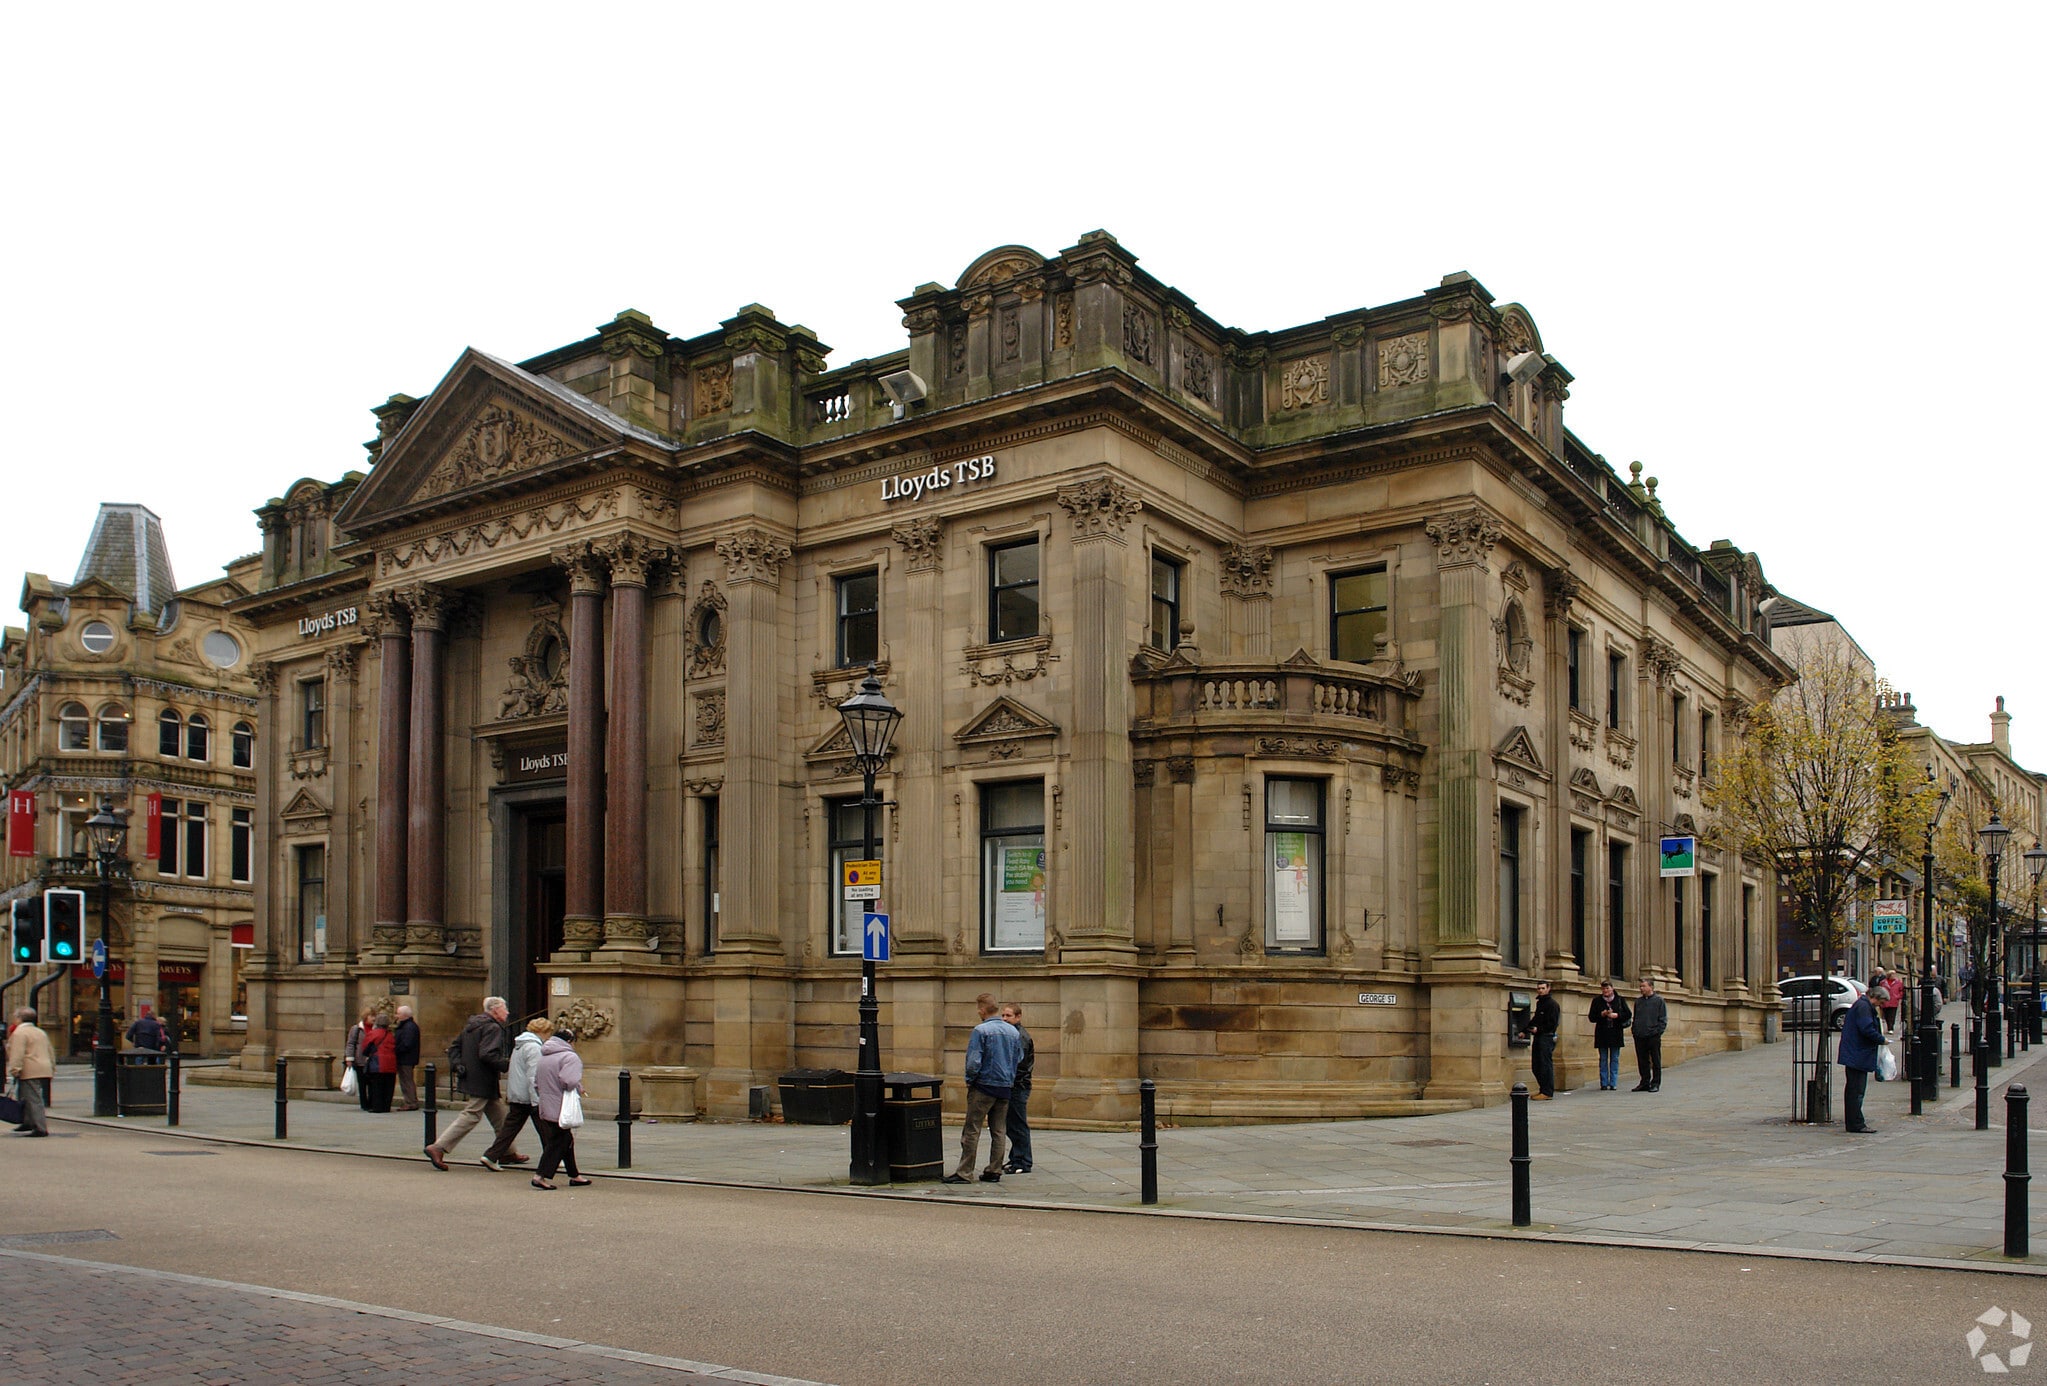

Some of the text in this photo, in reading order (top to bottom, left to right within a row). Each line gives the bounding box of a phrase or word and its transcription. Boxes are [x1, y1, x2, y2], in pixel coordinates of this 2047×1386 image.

[880, 455, 995, 500] Lloyds TSB
[298, 607, 358, 637] Lloyds TSB
[520, 754, 550, 773] Lloyds
[14, 797, 31, 814] H
[148, 800, 157, 816] H
[1361, 994, 1395, 1003] GEORGE ST
